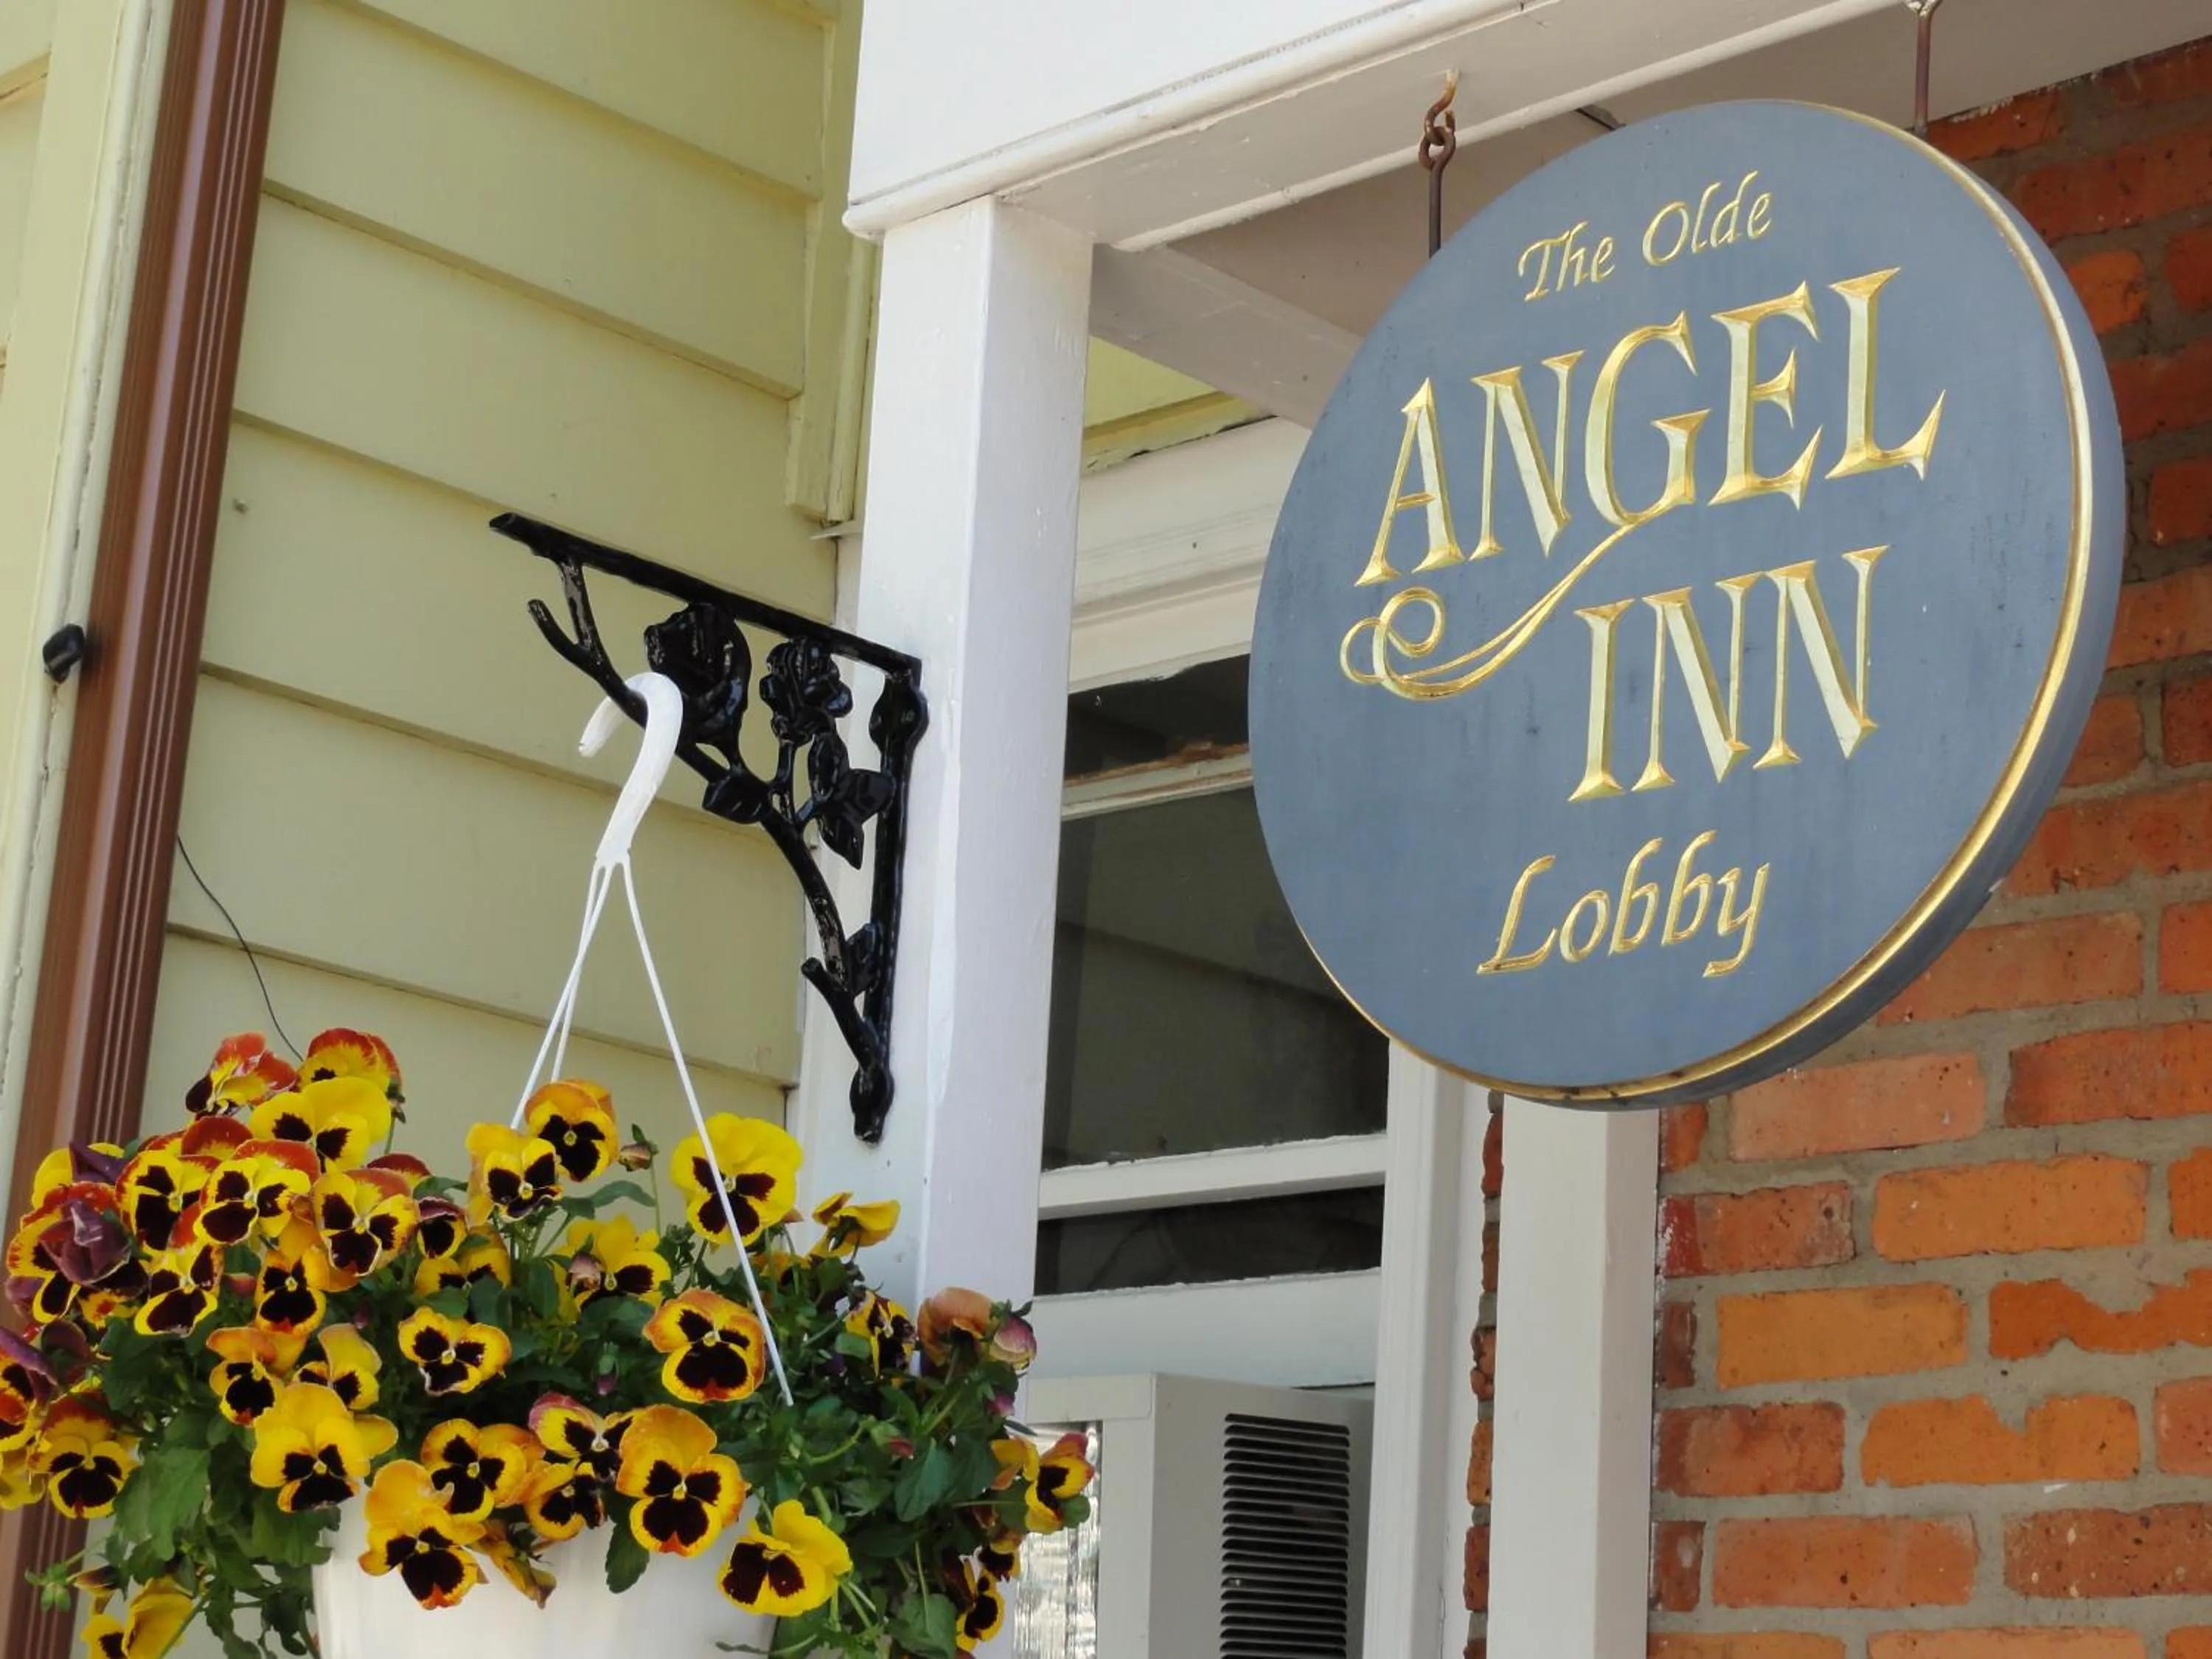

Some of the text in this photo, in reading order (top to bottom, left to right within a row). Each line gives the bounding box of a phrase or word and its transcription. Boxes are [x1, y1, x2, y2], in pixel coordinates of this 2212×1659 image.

[1516, 170, 1773, 302] The Olde
[1354, 266, 1947, 588] ANGEL
[1568, 543, 1889, 804] INN
[1476, 830, 1771, 978] Lobby
